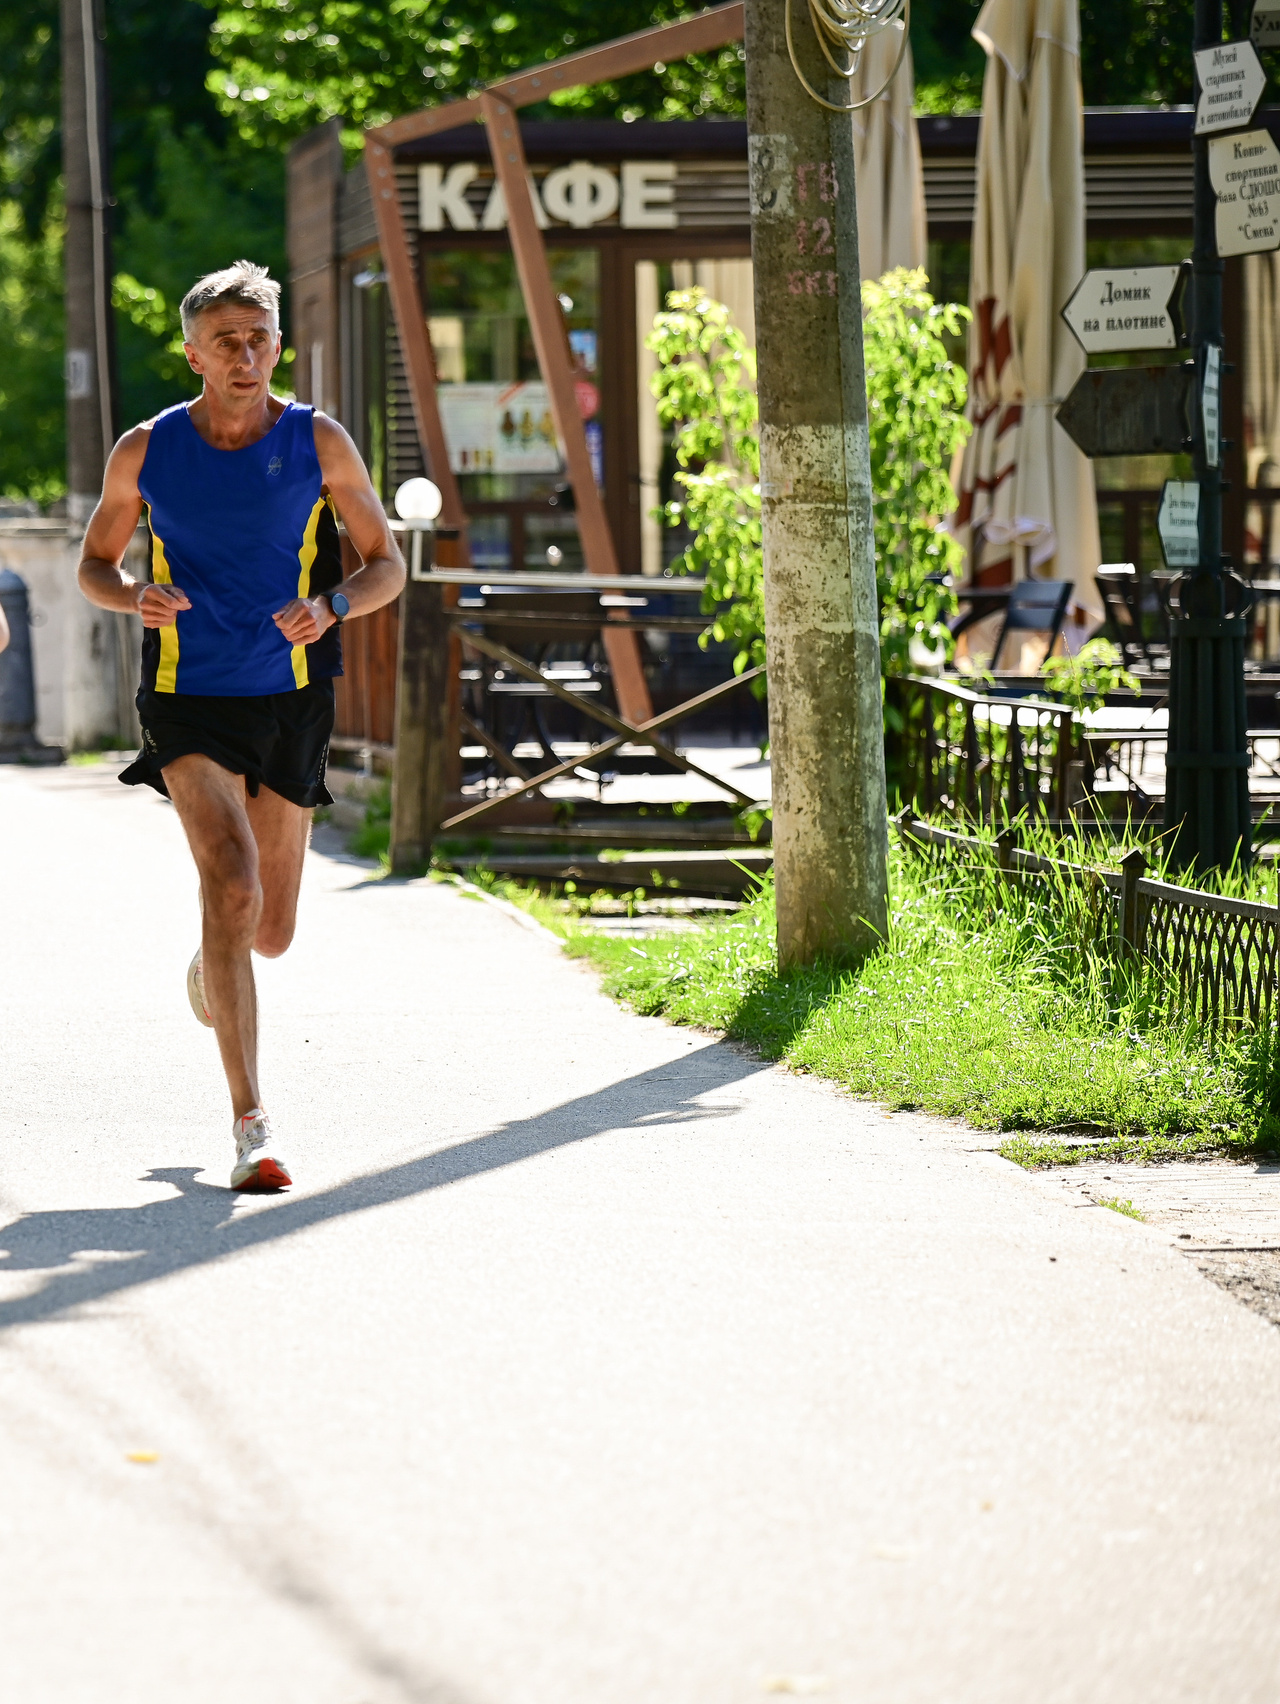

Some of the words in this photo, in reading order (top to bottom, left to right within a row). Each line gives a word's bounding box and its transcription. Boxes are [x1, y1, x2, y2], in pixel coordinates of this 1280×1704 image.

[1225, 164, 1279, 185] спортивная
[417, 158, 678, 232] КАФЕ
[1100, 280, 1152, 306] Домик
[1083, 318, 1100, 332] на
[1105, 315, 1167, 332] плотине
